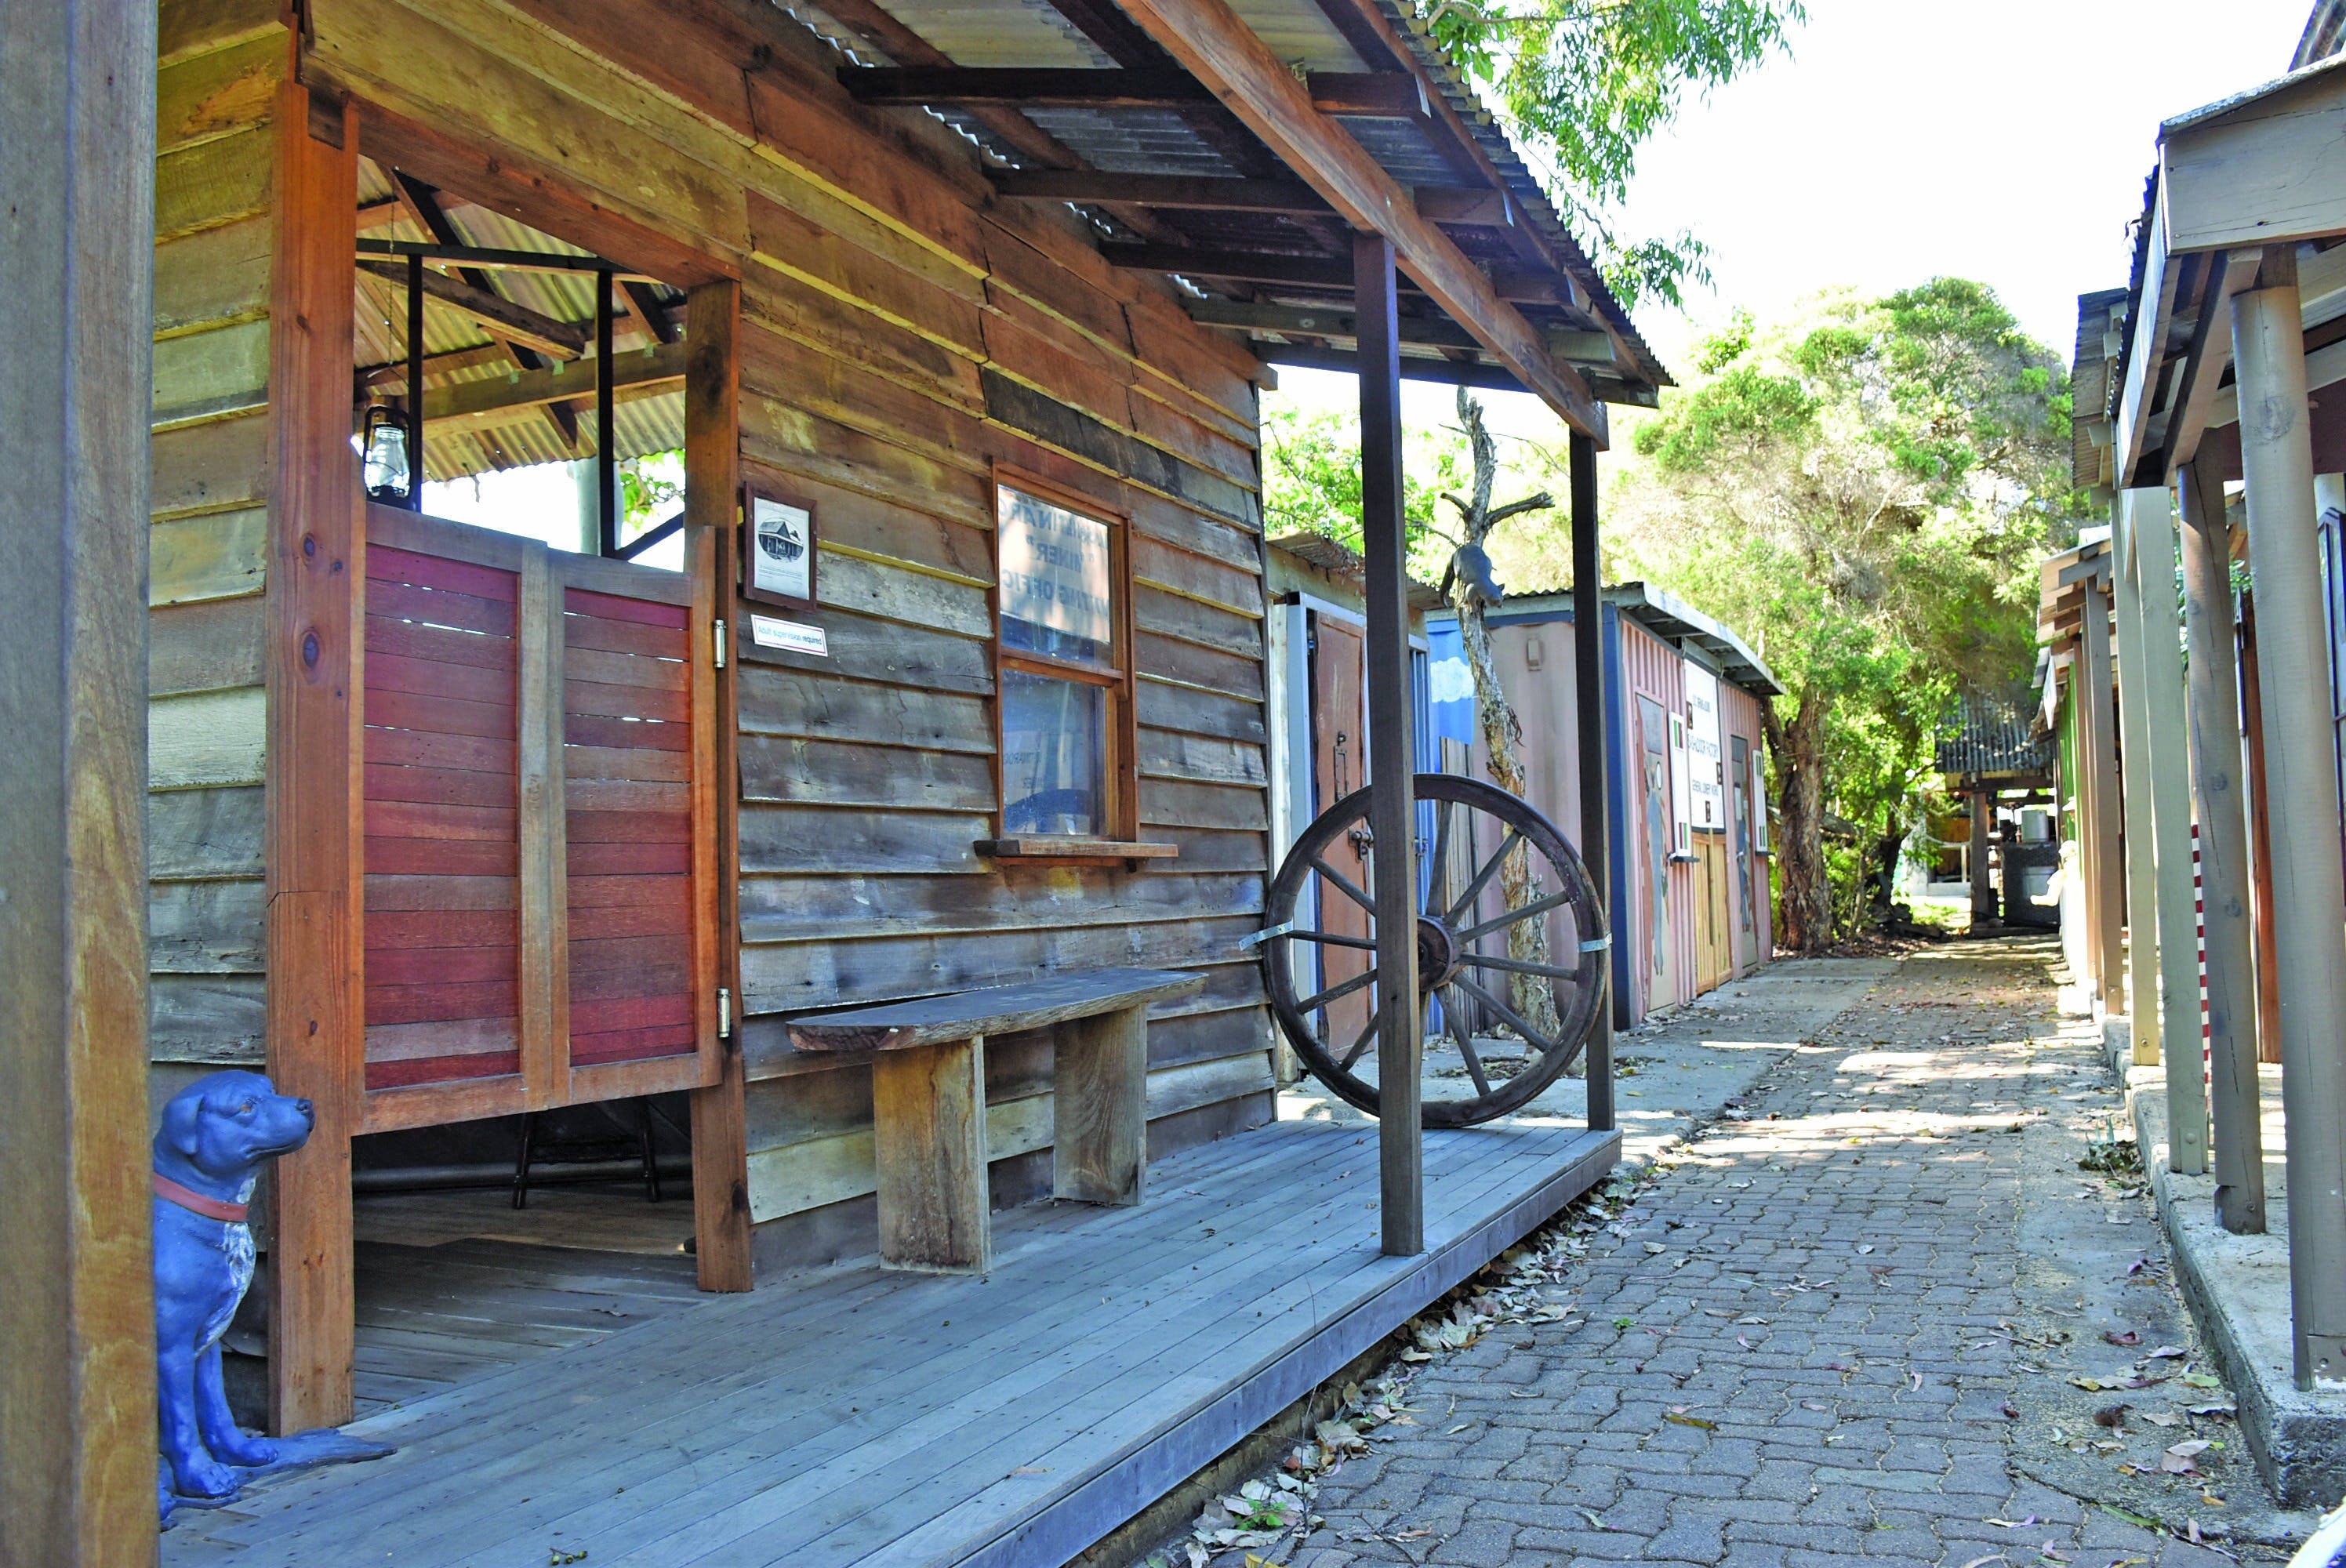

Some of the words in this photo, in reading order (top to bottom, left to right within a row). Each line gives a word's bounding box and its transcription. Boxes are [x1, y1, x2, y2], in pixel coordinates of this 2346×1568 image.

[758, 625, 772, 635] Adult
[773, 630, 801, 641] supervision
[802, 635, 823, 645] required
